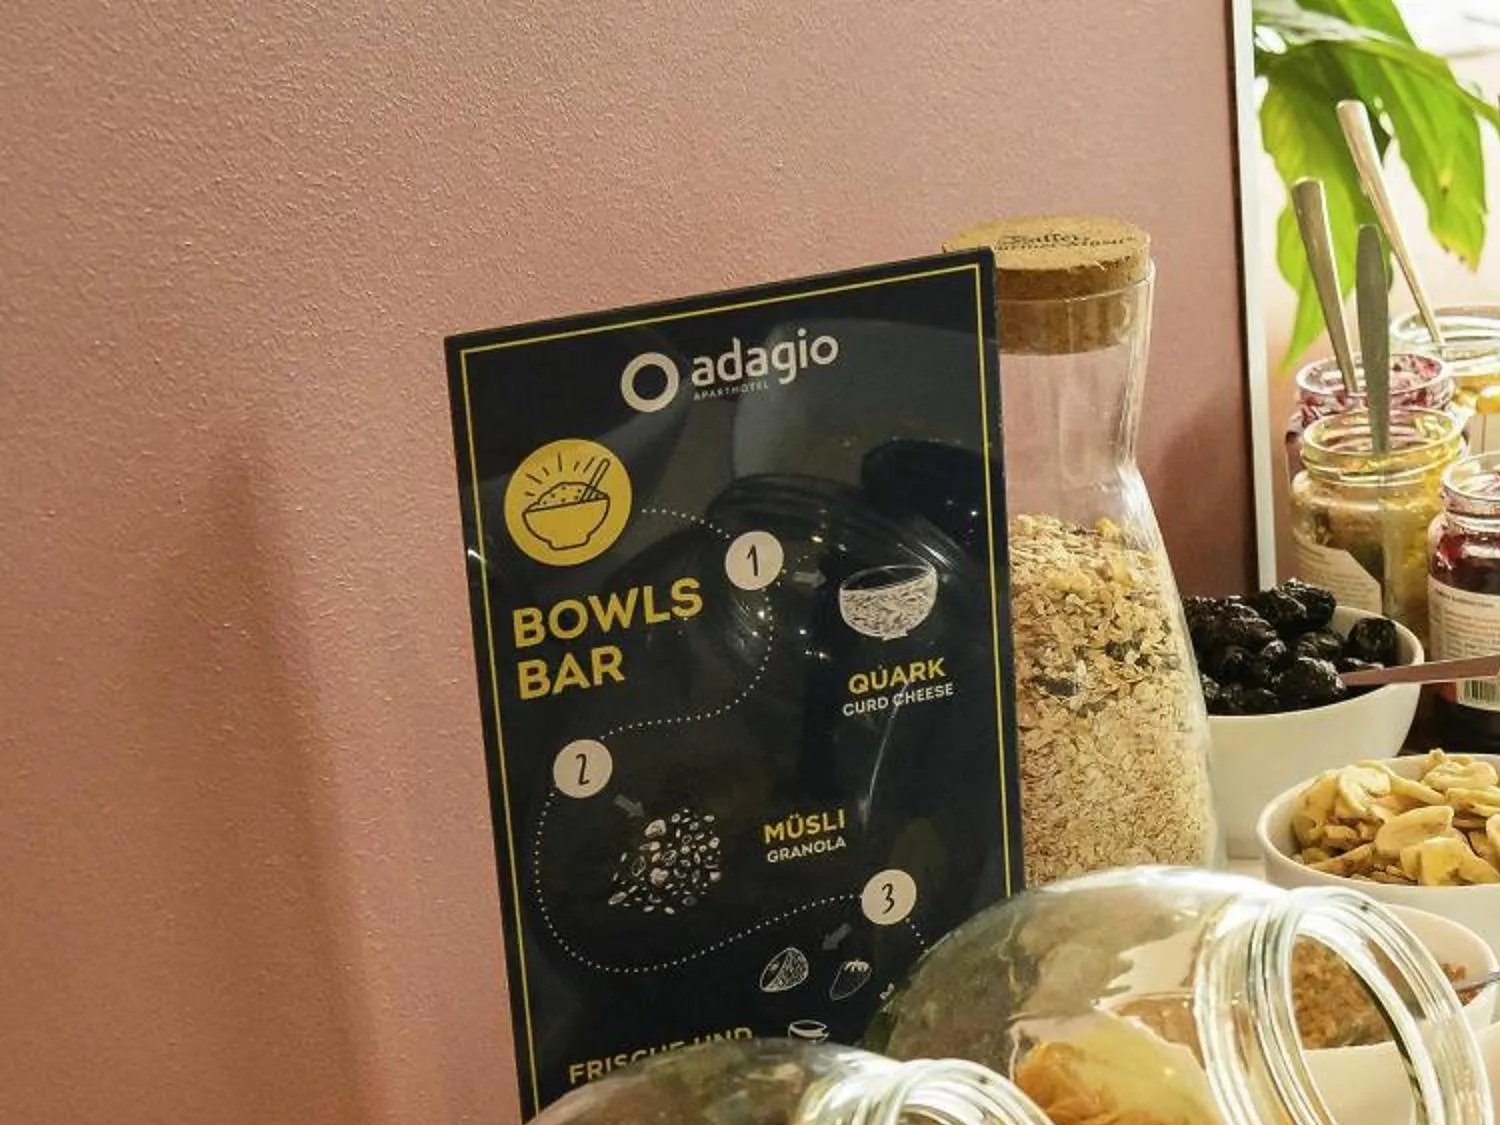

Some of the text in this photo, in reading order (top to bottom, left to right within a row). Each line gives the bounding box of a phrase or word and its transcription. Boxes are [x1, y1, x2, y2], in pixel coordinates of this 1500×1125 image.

[690, 327, 839, 386] adagio
[693, 381, 770, 401] APARTHOTEL
[747, 544, 759, 577] 1
[512, 577, 703, 648] BOWLS
[517, 645, 625, 700] BAR
[848, 657, 946, 694] QUARK
[842, 682, 954, 717] CURD CHEESE
[576, 753, 590, 786] 2
[763, 808, 846, 844] MÜSLI
[767, 836, 847, 863] GRANOLA
[881, 883, 895, 916] 3
